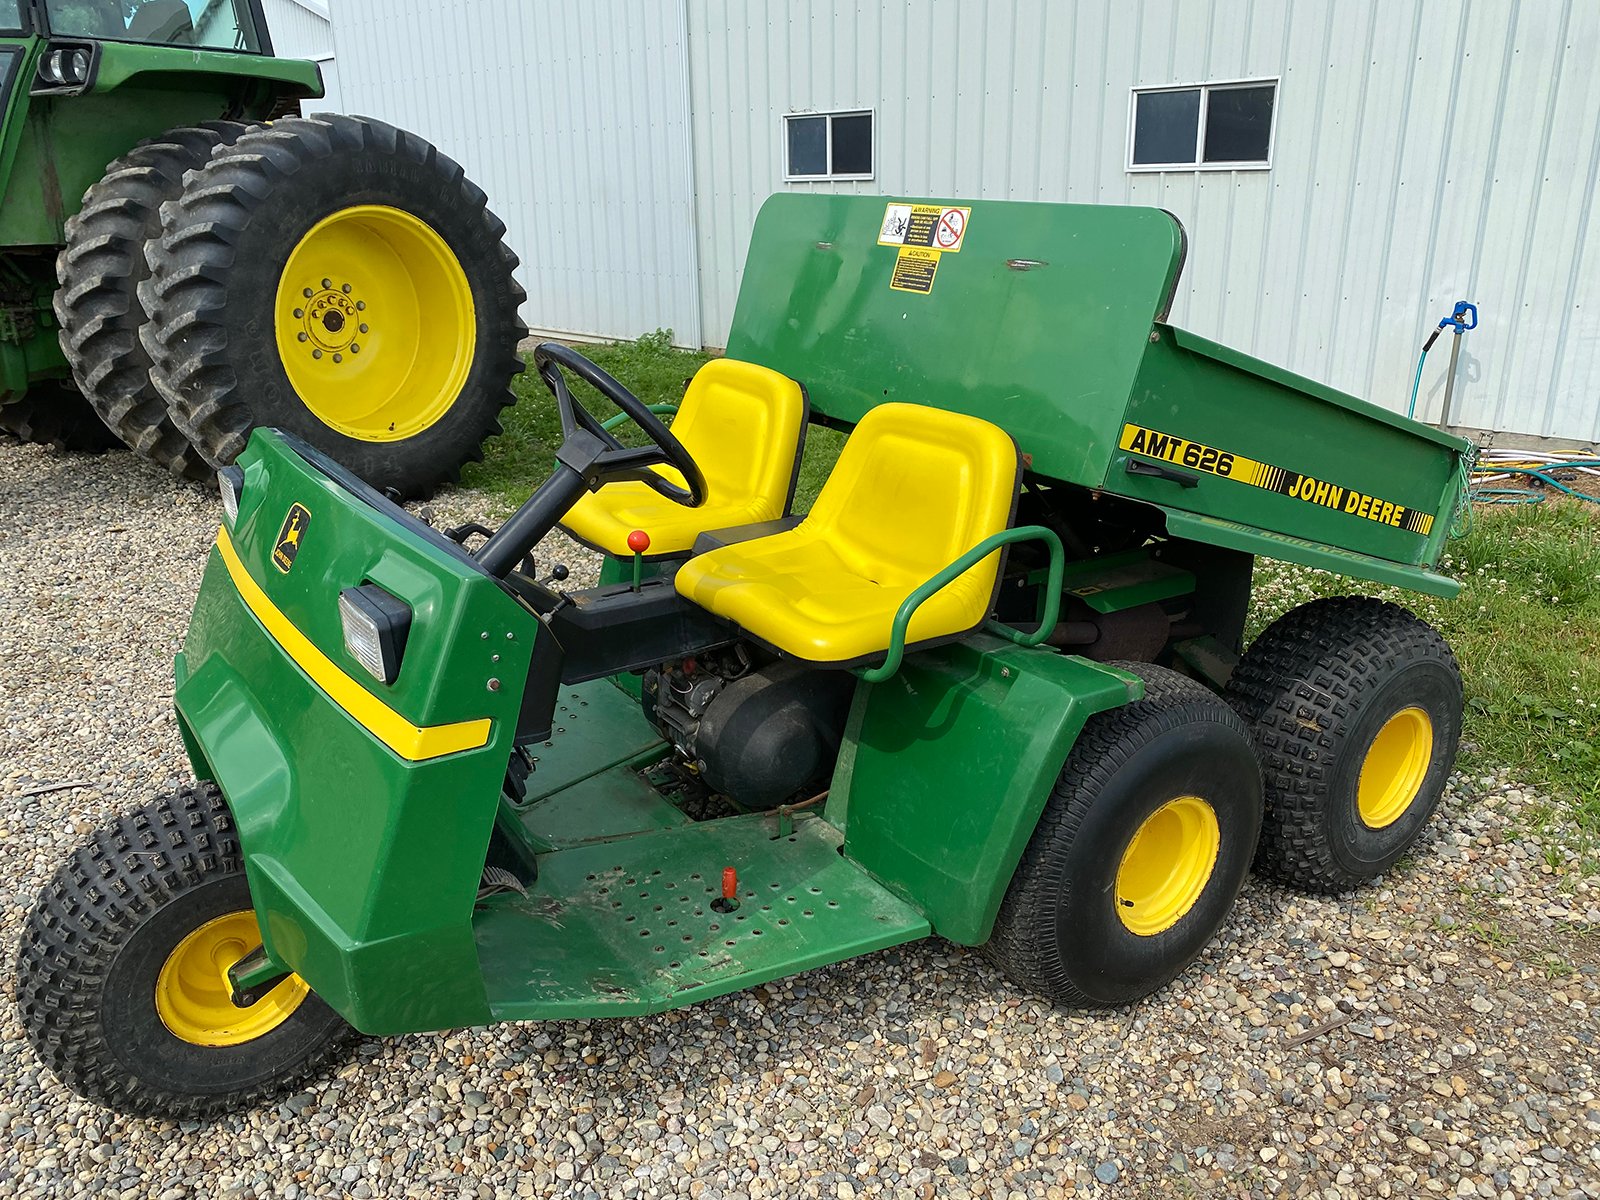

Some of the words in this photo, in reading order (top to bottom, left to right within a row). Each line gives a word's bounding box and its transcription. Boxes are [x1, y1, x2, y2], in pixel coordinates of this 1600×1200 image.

[1129, 429, 1182, 461] AMT
[1182, 443, 1235, 476] 626
[1288, 474, 1344, 510] JOHN
[1344, 491, 1406, 528] DEERE
